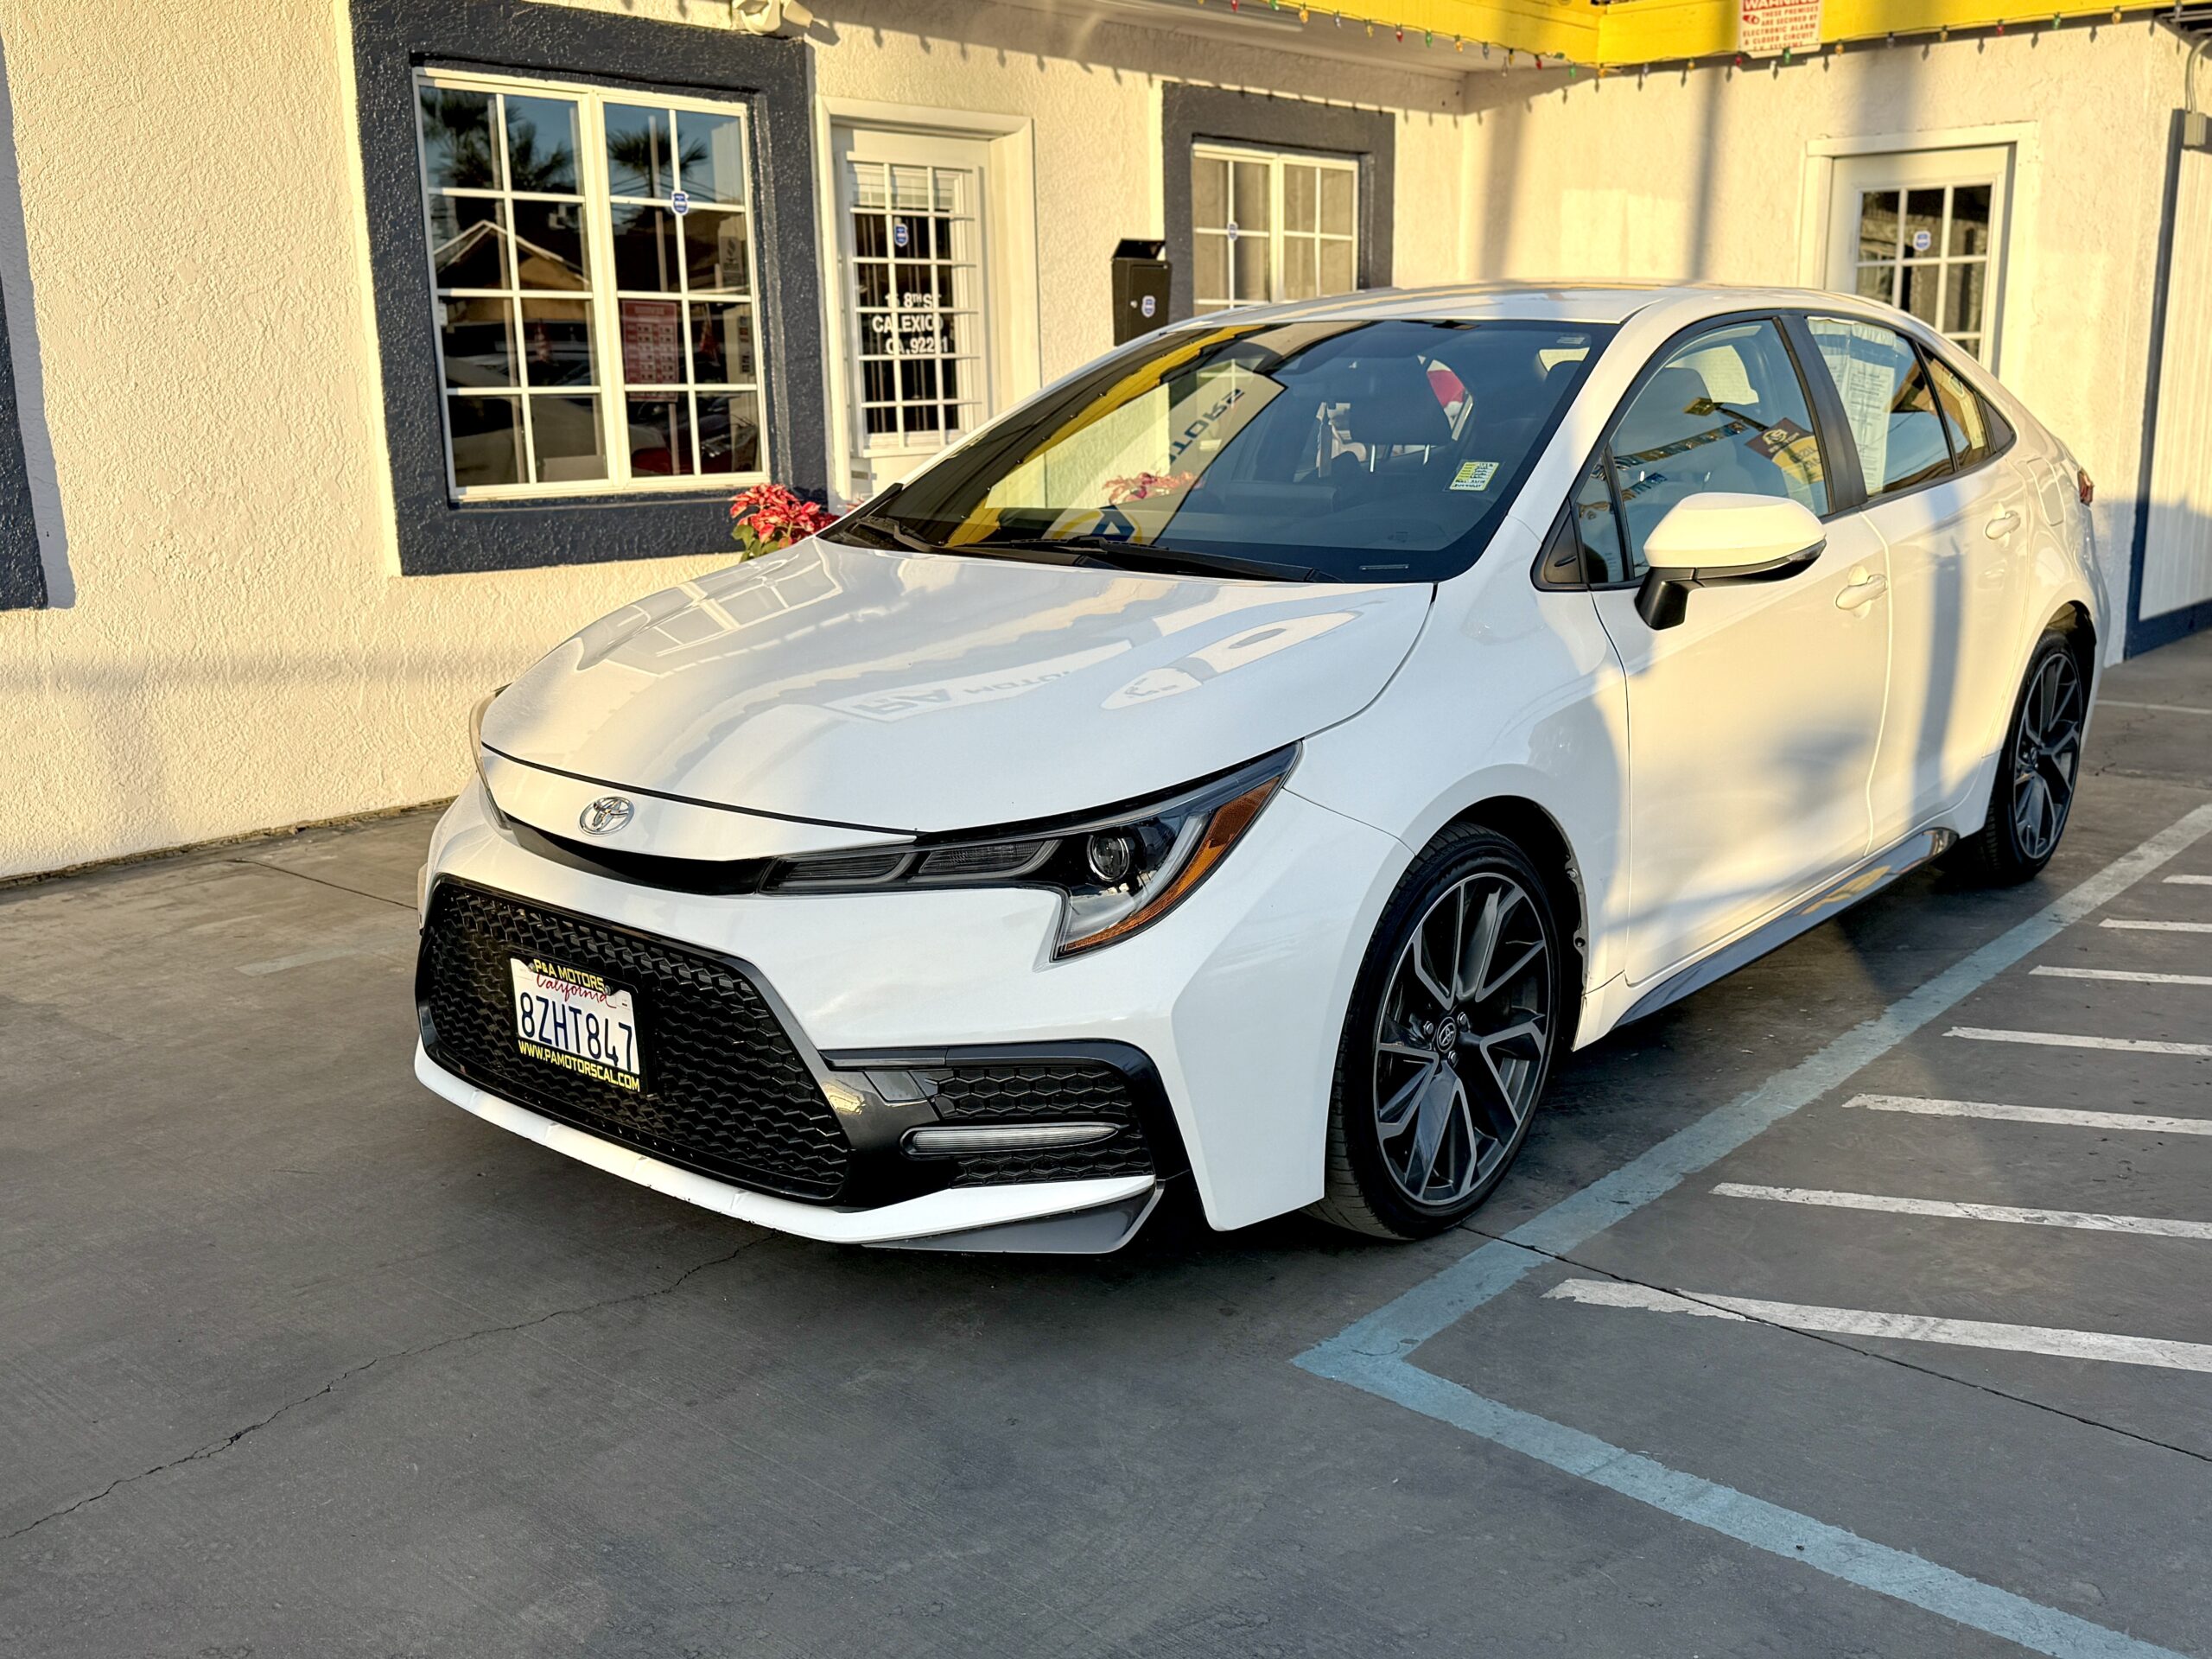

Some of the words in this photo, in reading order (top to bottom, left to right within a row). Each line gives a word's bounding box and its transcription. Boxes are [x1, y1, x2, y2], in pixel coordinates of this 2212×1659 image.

[1743, 26, 1787, 37] ELECTRONIC
[1777, 16, 1807, 24] SECURED
[1752, 35, 1780, 44] CLOSED
[1783, 32, 1814, 41] CIRCUIT
[873, 314, 944, 334] CAEXIC
[533, 958, 557, 978] P&A
[557, 965, 605, 994] MOTORS
[537, 973, 617, 1009] California
[520, 992, 632, 1072] 8ZHT847
[518, 1039, 640, 1093] WWW.PAMOTORSCAL.COM
